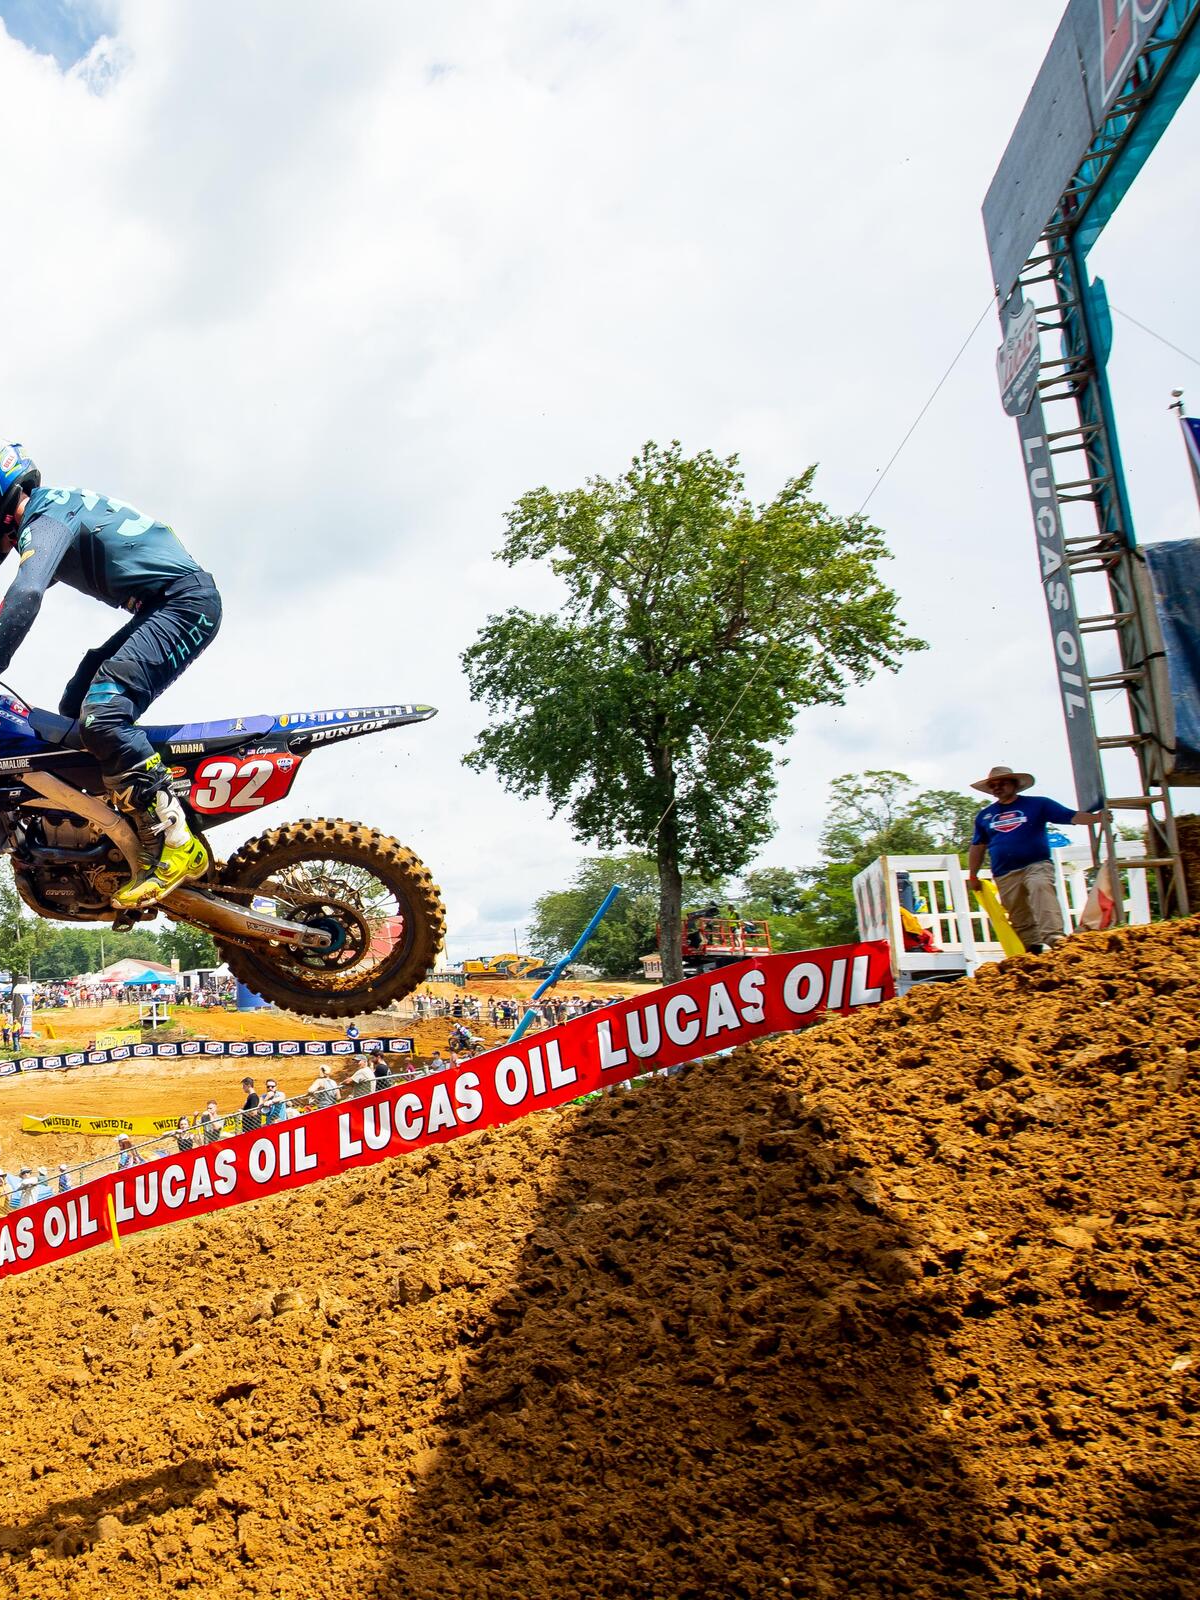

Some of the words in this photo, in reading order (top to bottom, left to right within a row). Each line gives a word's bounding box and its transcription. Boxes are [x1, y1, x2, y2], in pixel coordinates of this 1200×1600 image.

[1022, 436, 1069, 612] LUCAS
[1056, 630, 1086, 719] OIL
[310, 719, 390, 743] DUNLOP
[170, 743, 205, 754] YAMAHA
[195, 759, 274, 809] 32
[596, 968, 767, 1071] LUCAS
[782, 953, 884, 1015] OIL
[256, 1044, 271, 1053] 100%
[281, 1044, 297, 1053] 100%
[307, 1043, 325, 1053] 100%
[334, 1043, 353, 1052] 100%
[362, 1042, 381, 1052] 100%
[391, 1041, 408, 1051] 100%
[338, 1070, 484, 1160] LUCAS
[494, 1038, 578, 1106] OIL
[41, 1117, 71, 1128] TWISTED
[89, 1119, 119, 1130] TWISTED
[119, 1119, 133, 1131] TEA
[153, 1118, 181, 1130] TWISTE
[113, 1148, 238, 1224] LUCAS
[248, 1126, 318, 1184] OIL
[42, 1194, 99, 1249] OIL
